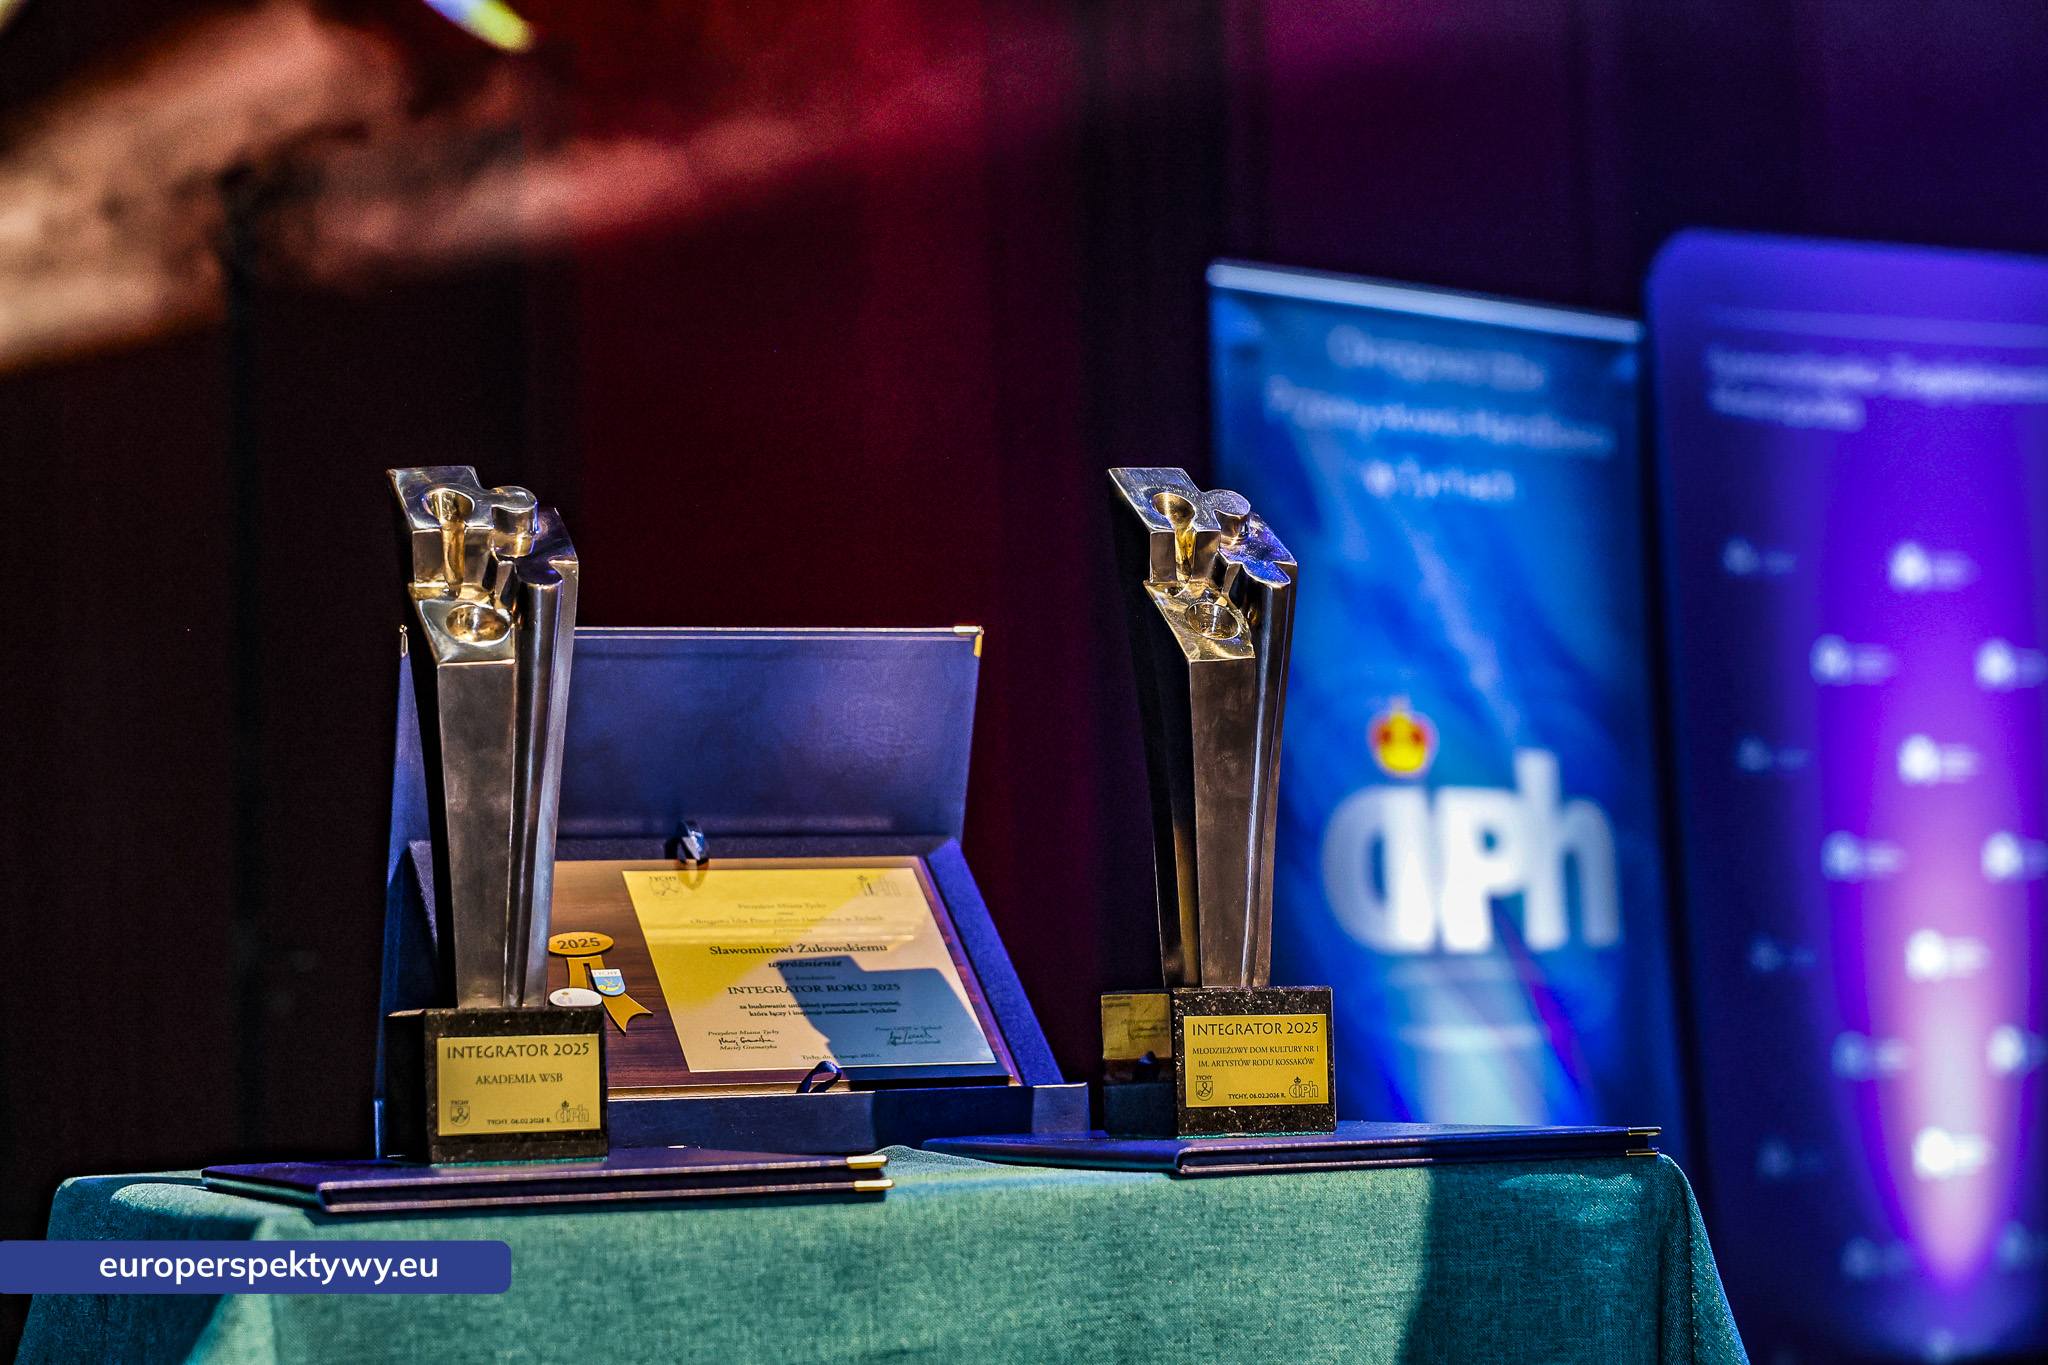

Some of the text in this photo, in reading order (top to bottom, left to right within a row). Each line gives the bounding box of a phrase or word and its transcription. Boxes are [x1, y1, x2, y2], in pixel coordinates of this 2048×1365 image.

[556, 937, 601, 950] 2025
[709, 943, 888, 956] Sławomirowi Żukowskiemu
[768, 959, 843, 969] wyróżnienie
[727, 983, 901, 995] INTEGRATOR ROKU 2025
[1192, 1021, 1318, 1036] INTEGRATOR 2025
[447, 1042, 590, 1059] INTEGRATOR 2025
[1192, 1045, 1249, 1055] MŁODZIEŻOWY
[1250, 1046, 1269, 1054] DOM
[1304, 1045, 1315, 1053] NR
[1198, 1056, 1315, 1068] IM. ARTYSTÓW RODU KOSSAKÓW
[475, 1072, 563, 1085] AKADEMIA WSB
